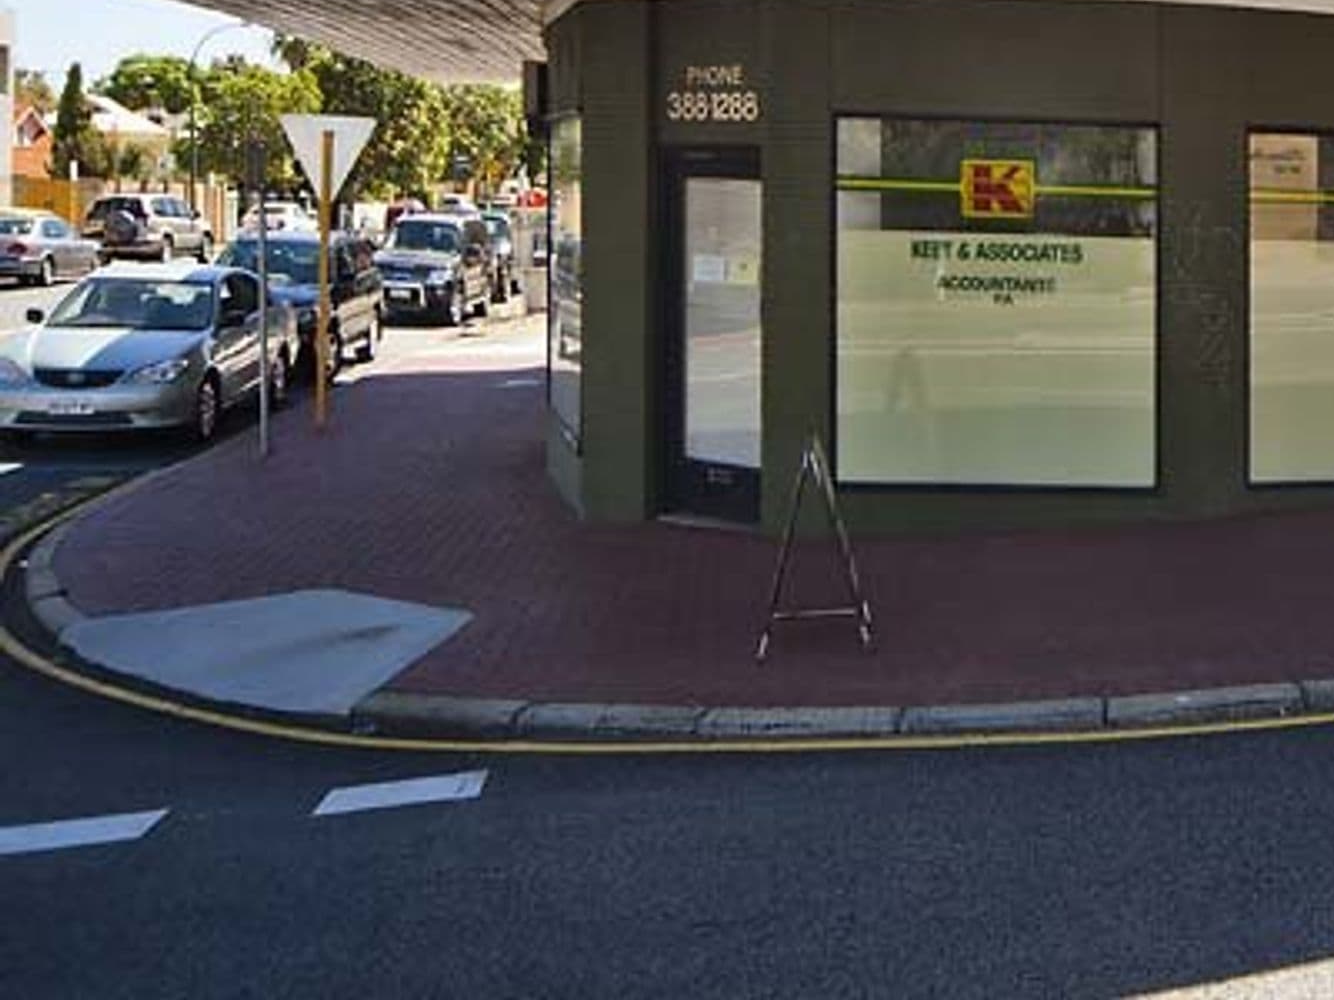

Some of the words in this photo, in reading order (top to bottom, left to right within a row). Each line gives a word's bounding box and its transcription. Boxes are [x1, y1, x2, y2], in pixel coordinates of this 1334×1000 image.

[686, 66, 743, 85] PHONE
[973, 164, 1024, 213] K
[975, 242, 1083, 263] ASSOCIATES
